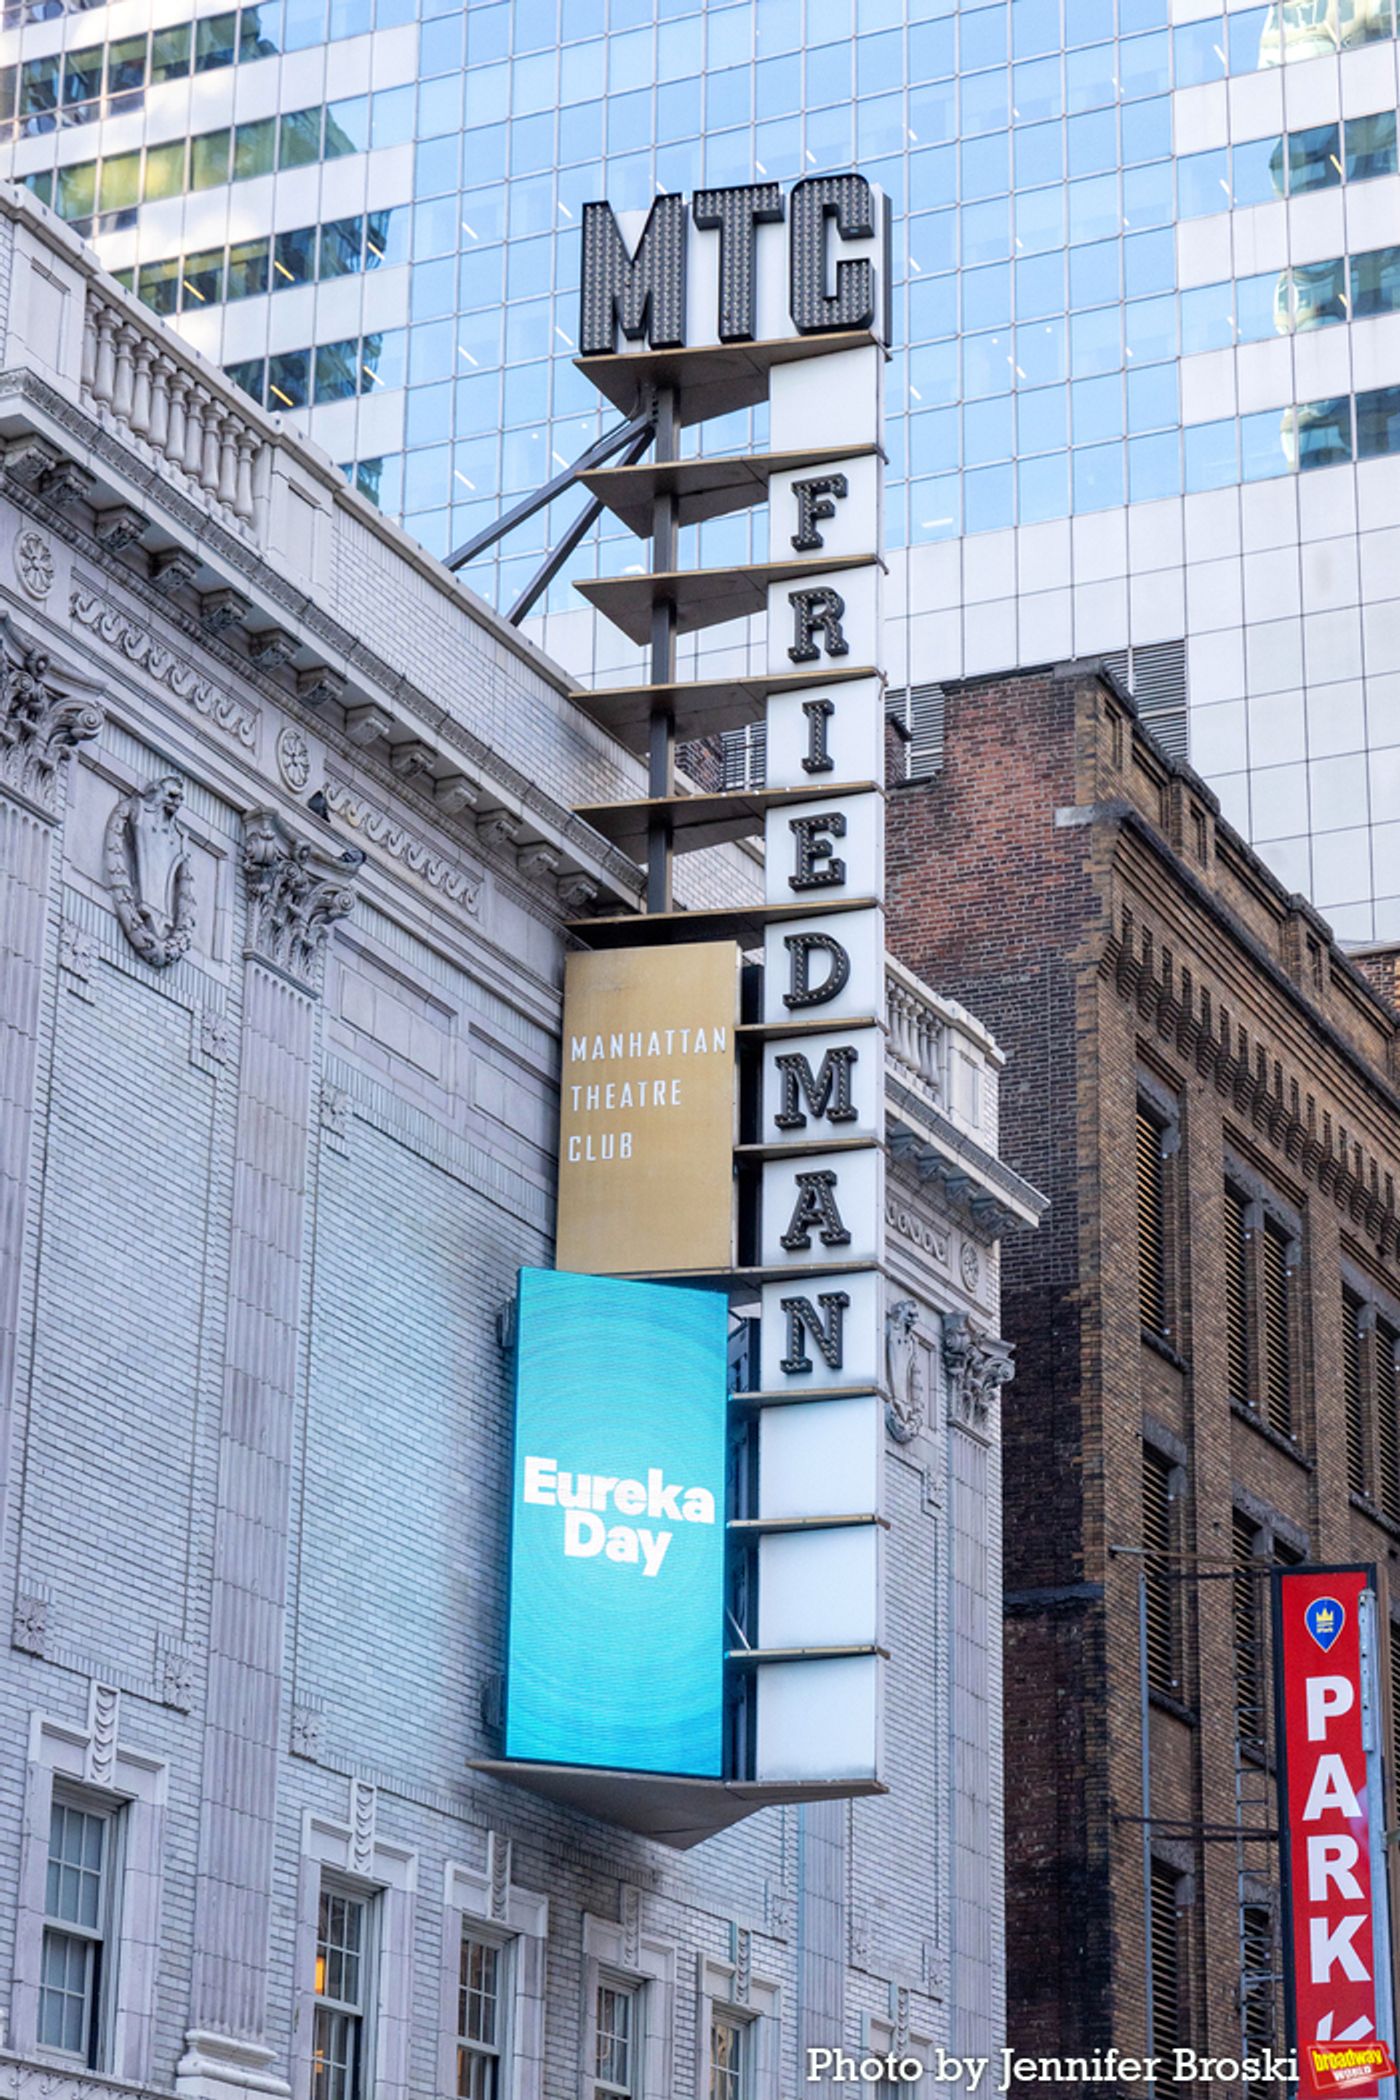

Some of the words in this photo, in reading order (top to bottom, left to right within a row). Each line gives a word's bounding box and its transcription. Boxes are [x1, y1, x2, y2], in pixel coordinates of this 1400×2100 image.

[580, 174, 875, 356] MTC
[775, 473, 858, 1375] FRIEDMAN
[571, 1026, 727, 1062] MANHATTAN
[571, 1080, 681, 1112] THEATRE
[568, 1132, 633, 1162] CLUB
[523, 1456, 715, 1524] Eureka
[564, 1510, 672, 1577] Day
[1302, 1675, 1371, 1984] PARK
